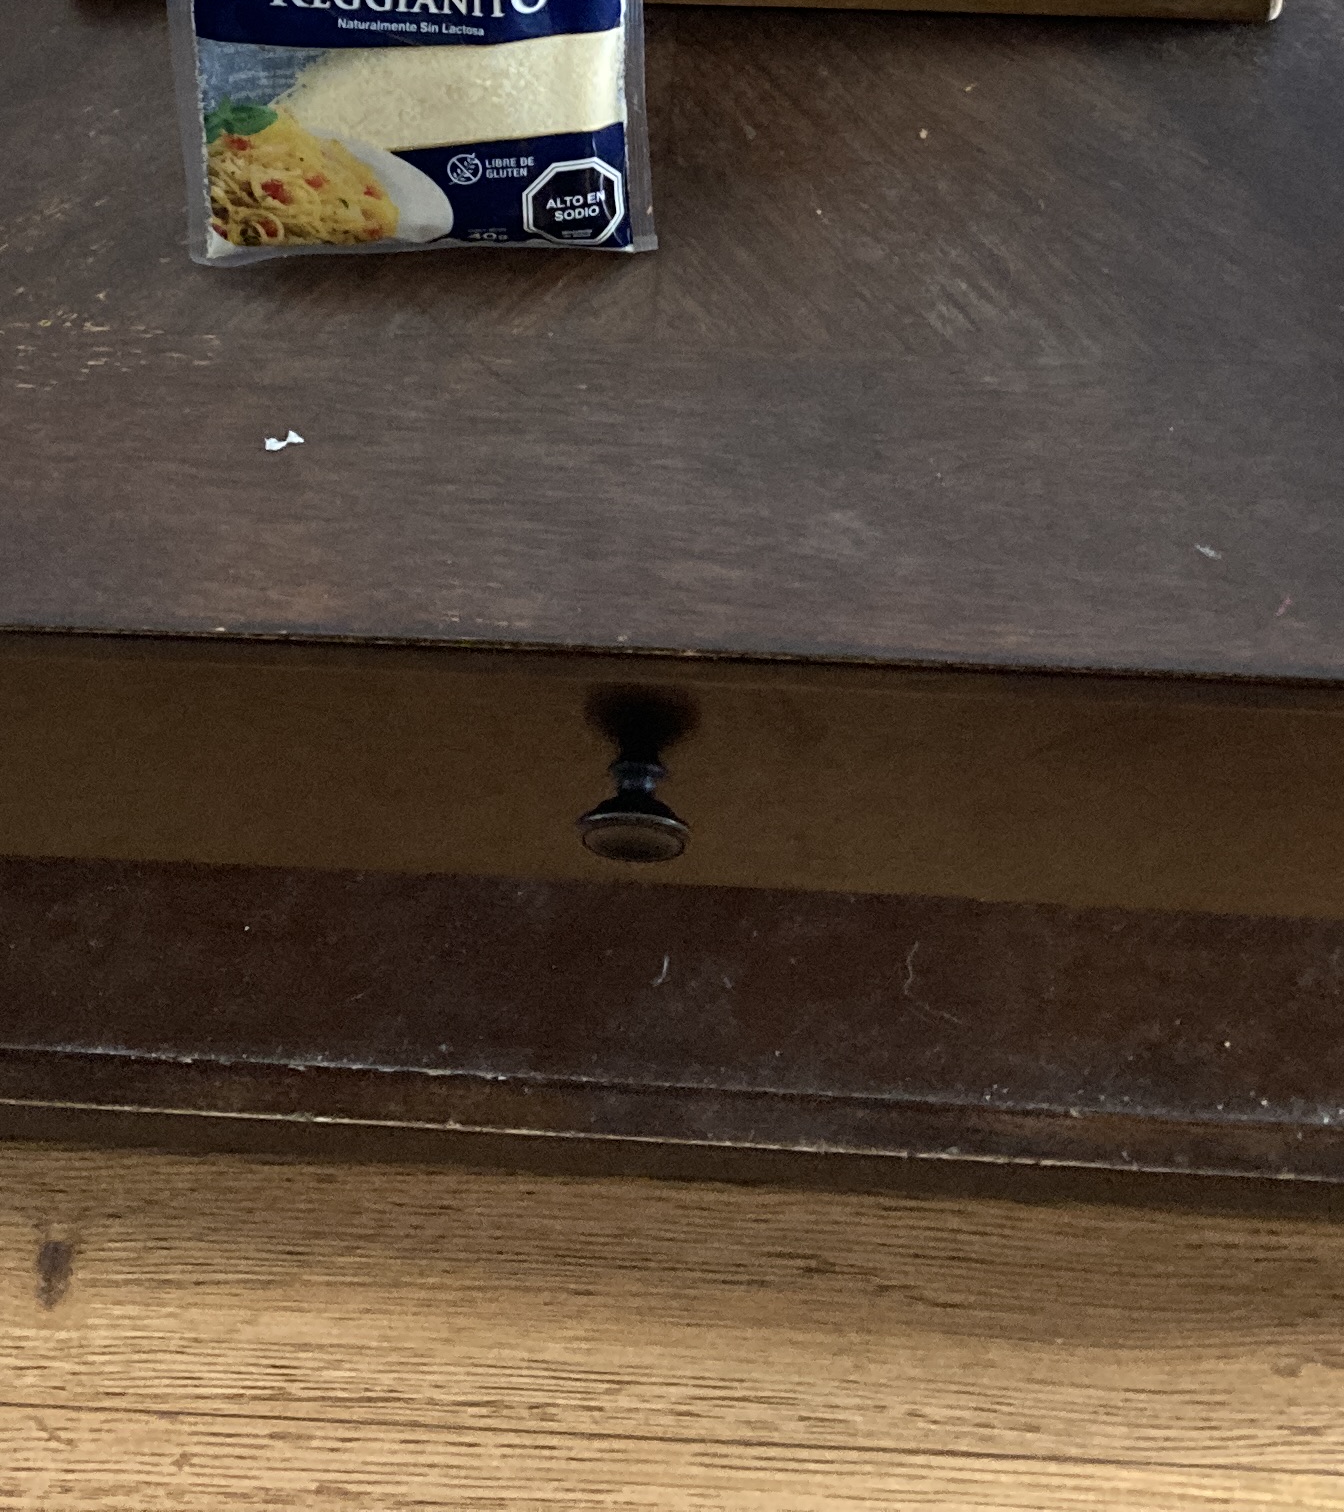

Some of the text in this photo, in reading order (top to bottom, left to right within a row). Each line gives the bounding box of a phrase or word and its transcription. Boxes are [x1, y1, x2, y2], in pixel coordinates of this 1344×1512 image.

[337, 17, 485, 37] Naturalmente Sin Lactosa
[485, 156, 535, 169] LIBRE DE
[485, 167, 528, 179] GLUTEN
[546, 190, 606, 210] ALTO EN
[554, 205, 600, 222] SODIO
